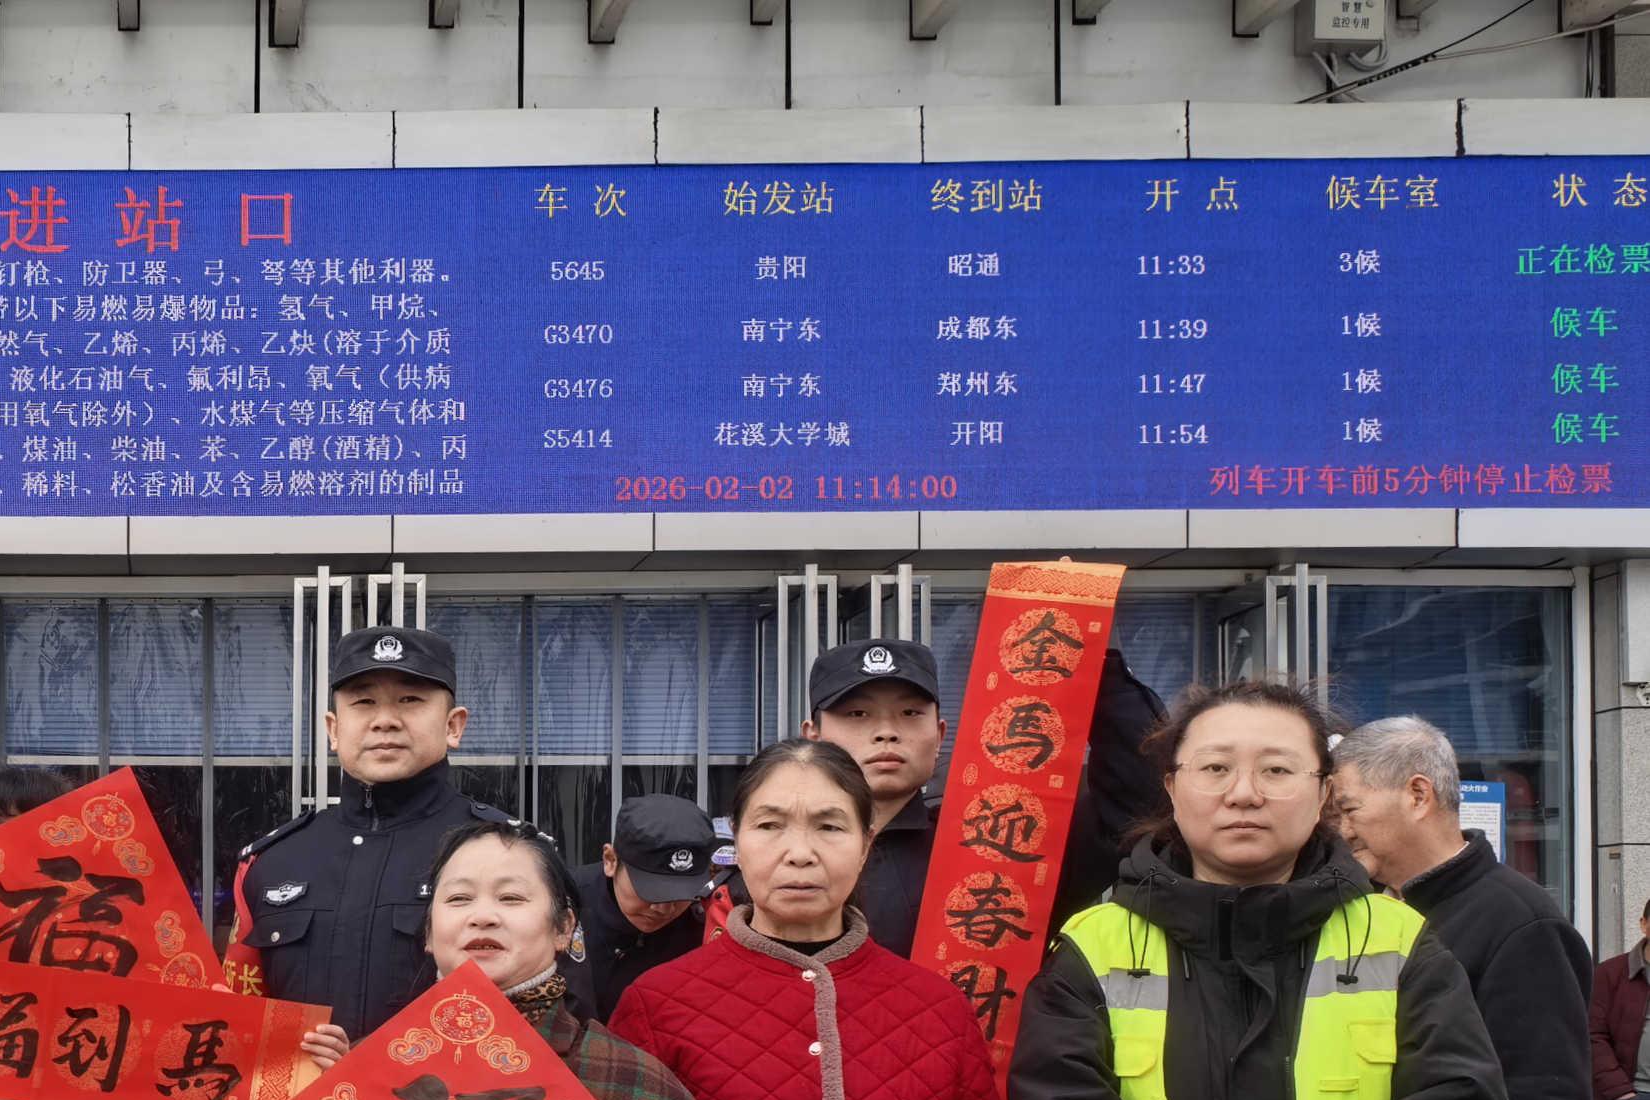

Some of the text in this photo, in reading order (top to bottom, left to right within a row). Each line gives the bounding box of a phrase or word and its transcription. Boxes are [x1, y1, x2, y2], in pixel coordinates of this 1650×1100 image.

[533, 171, 1648, 219] 车次 始发站 终到站 开点 候车室 状态
[551, 242, 1650, 281] 5645 贵阳 昭通 11:33 3候 正在检票
[543, 306, 1619, 345] G3470 南宁东 成都东 11:39 1候 候车
[544, 362, 1620, 399] G3476 南宁东 郑州东 11:47 1候 候车
[543, 412, 1620, 449] S5414 花溪大学城 开阳 11:54 1候 候车
[615, 474, 958, 501] 2026-02-02 11:14:00
[1210, 463, 1613, 496] 列车开车前5分钟停止检票
